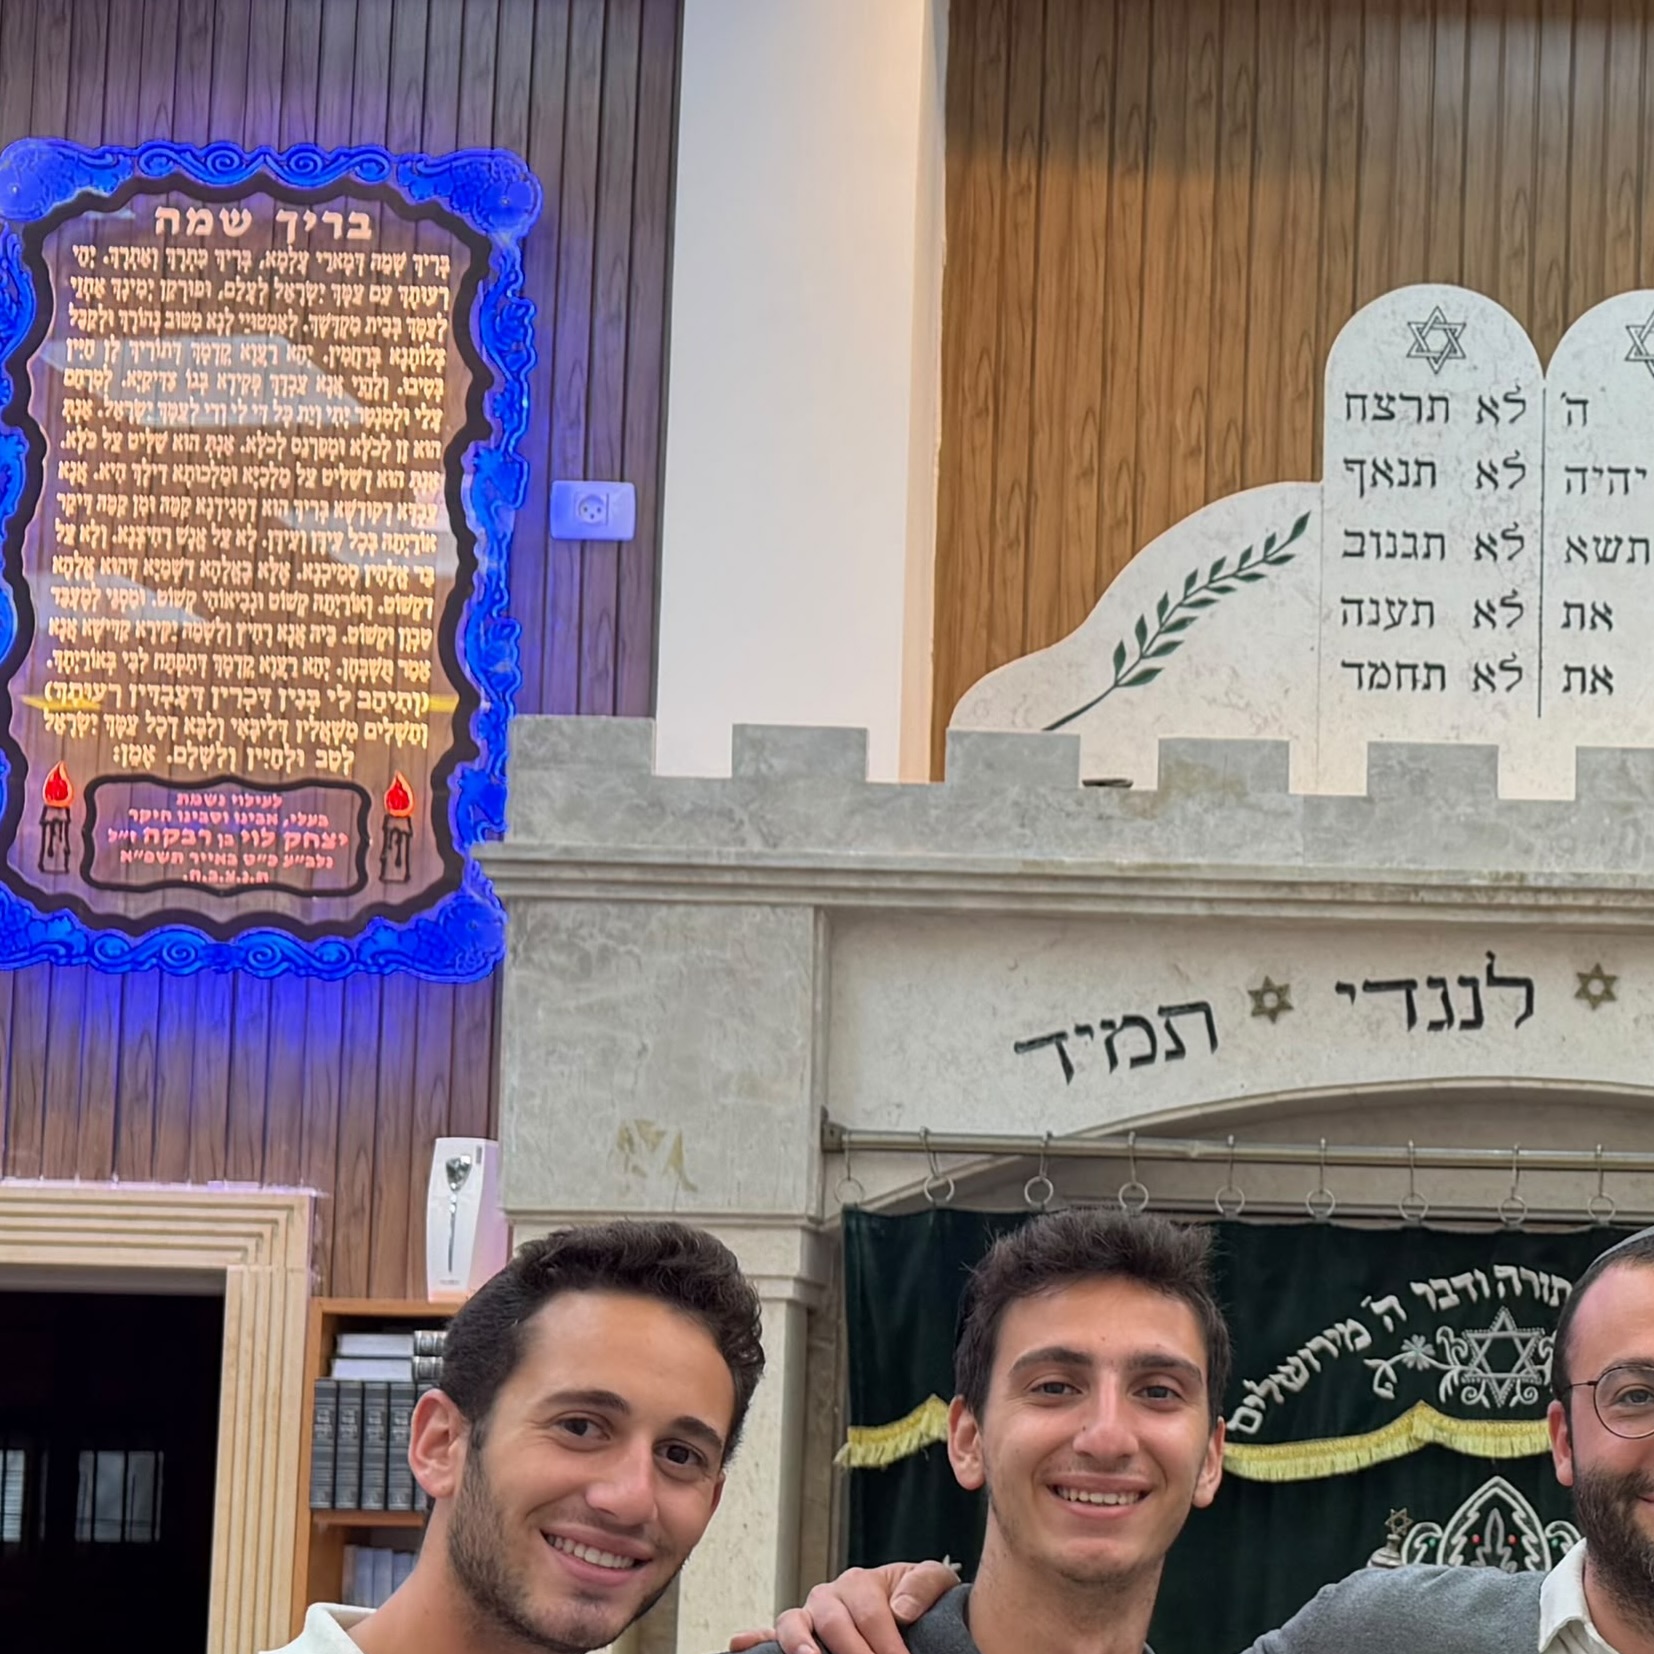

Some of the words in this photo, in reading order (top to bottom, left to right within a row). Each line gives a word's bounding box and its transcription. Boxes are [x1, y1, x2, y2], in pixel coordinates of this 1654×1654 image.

[154, 204, 252, 238] שמה
[275, 206, 374, 244] בריך
[1344, 391, 1450, 425] תרצח
[1475, 383, 1527, 429] לא
[1559, 391, 1590, 428] ה'
[1342, 456, 1437, 500] תנאף
[1475, 449, 1527, 492] לא
[1563, 465, 1648, 497] יהיה
[1341, 528, 1446, 562] תגנוב
[1473, 520, 1525, 564] לא
[1563, 534, 1651, 566] תשא
[1339, 595, 1435, 632] תענה
[1472, 587, 1525, 631] לא
[1560, 600, 1614, 633] את
[1340, 659, 1447, 692] תחמד
[1471, 651, 1524, 694] לא
[1561, 663, 1614, 697] את
[143, 827, 213, 849] רבקה
[241, 827, 276, 849] לוי
[283, 831, 349, 852] יצחק
[1334, 949, 1535, 1033] לנגדי
[1013, 1000, 1219, 1086] תמיד
[1410, 1268, 1491, 1313] ודבר
[1493, 1264, 1573, 1307] תורה
[1227, 1318, 1372, 1435] מירושלים
